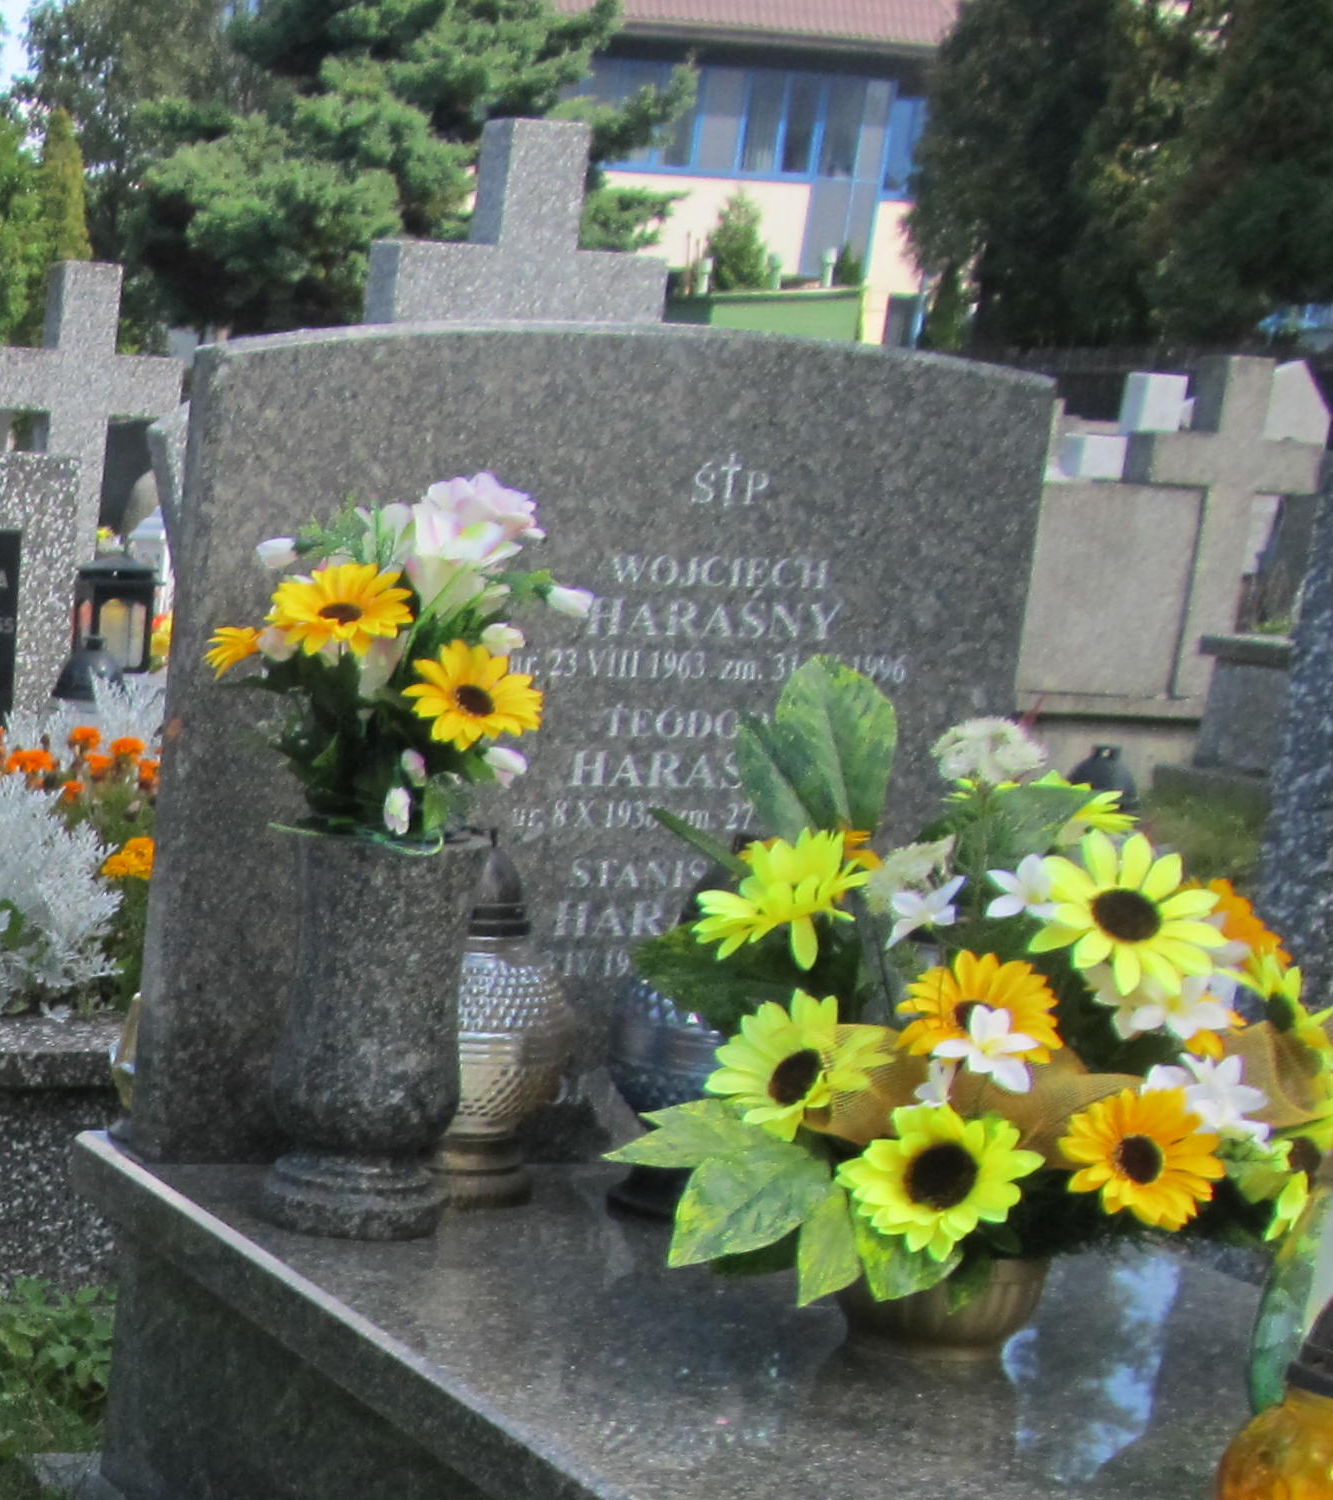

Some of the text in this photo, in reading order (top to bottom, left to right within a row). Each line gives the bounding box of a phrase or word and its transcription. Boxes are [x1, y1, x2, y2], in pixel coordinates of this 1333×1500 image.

[612, 553, 831, 590] WOJCIECH
[587, 588, 844, 640] HARAŚNY
[603, 702, 769, 740] TEODO
